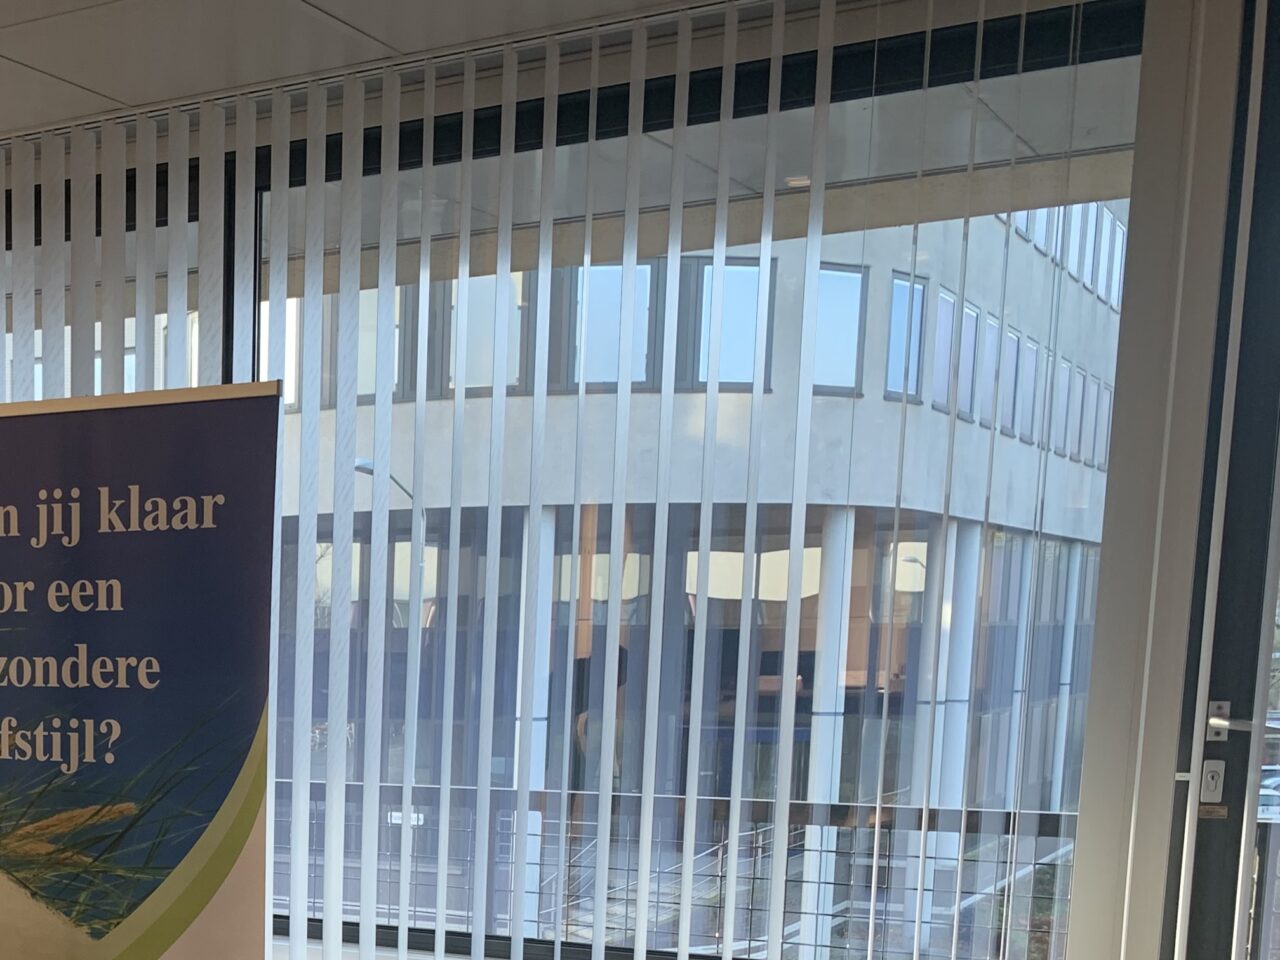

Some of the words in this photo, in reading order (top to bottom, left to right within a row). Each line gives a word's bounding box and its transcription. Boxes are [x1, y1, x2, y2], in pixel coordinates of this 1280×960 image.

[30, 487, 81, 548] jij
[97, 484, 225, 533] klaar
[47, 578, 124, 612] een
